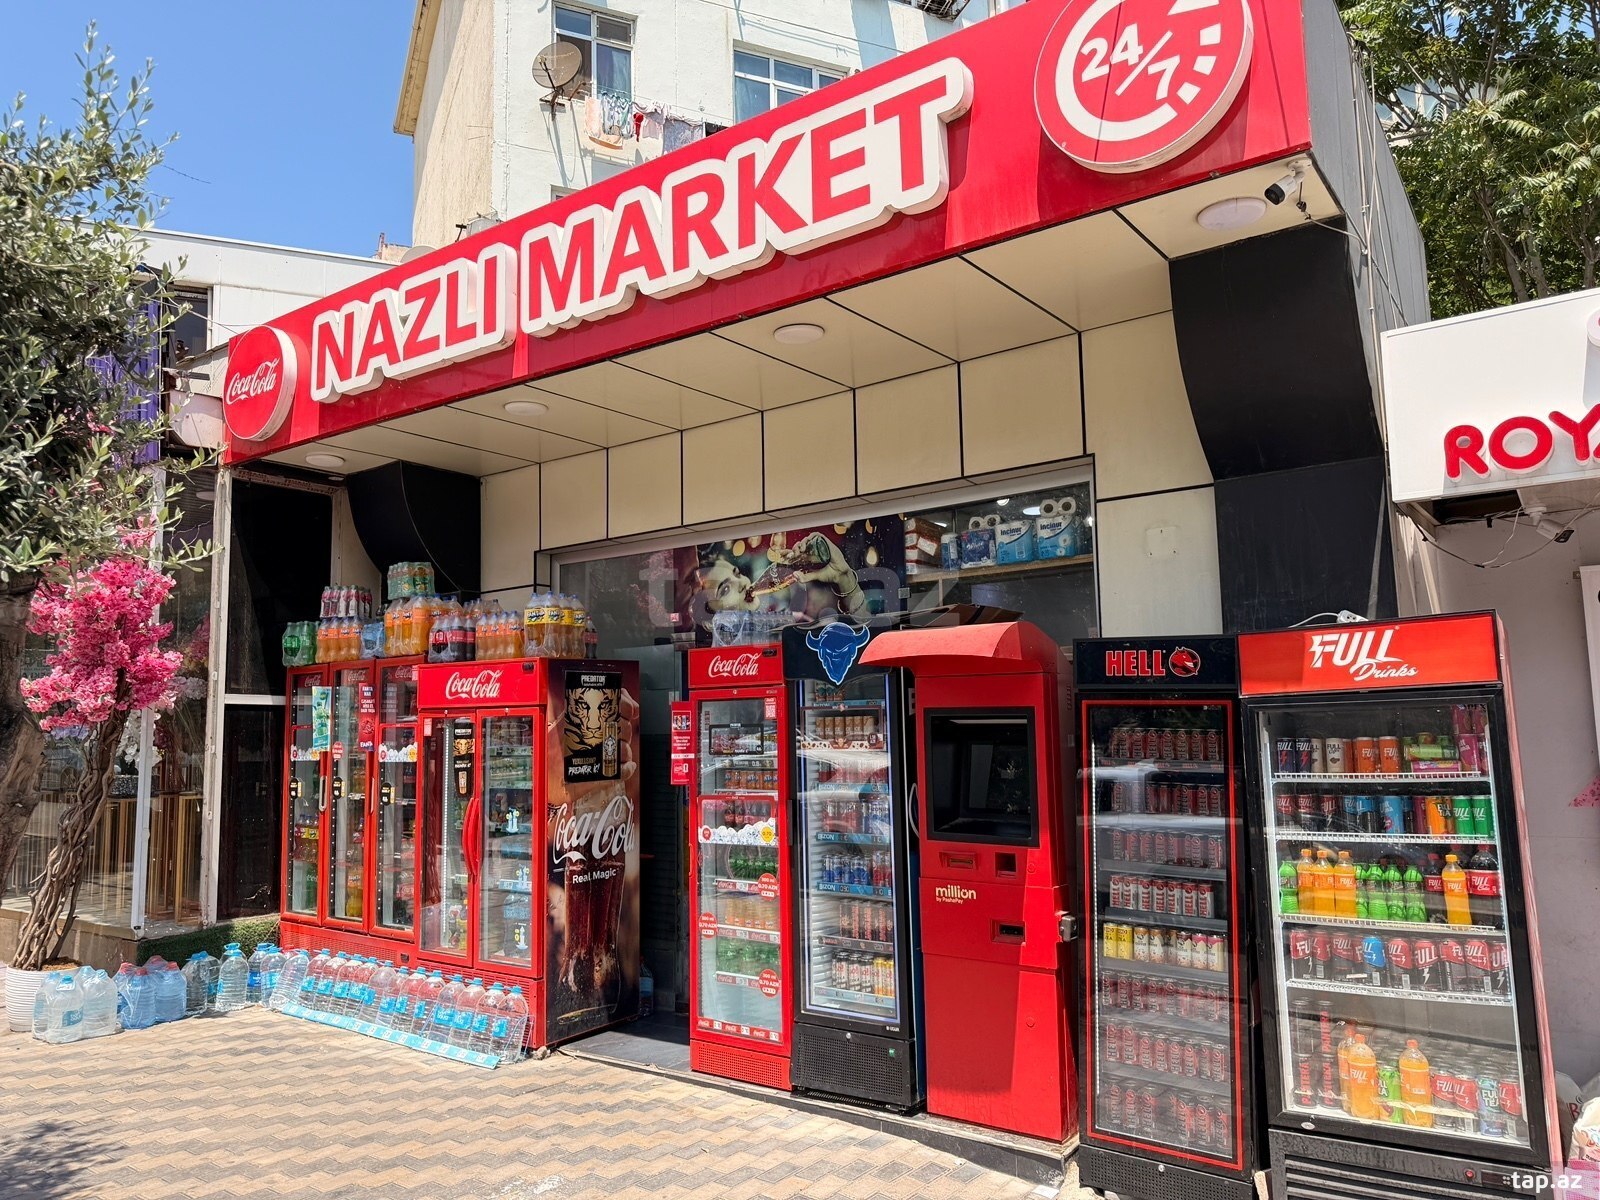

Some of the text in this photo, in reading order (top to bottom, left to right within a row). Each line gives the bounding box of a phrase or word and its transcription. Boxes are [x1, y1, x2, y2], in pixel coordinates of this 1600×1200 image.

[1081, 23, 1181, 101] 24/7
[316, 75, 947, 391] NAZLI MARKET
[1105, 650, 1166, 677] HELL
[1309, 629, 1419, 682] FULL Drinks
[445, 670, 504, 699] Coca-Cola
[572, 867, 617, 885] Real Magic
